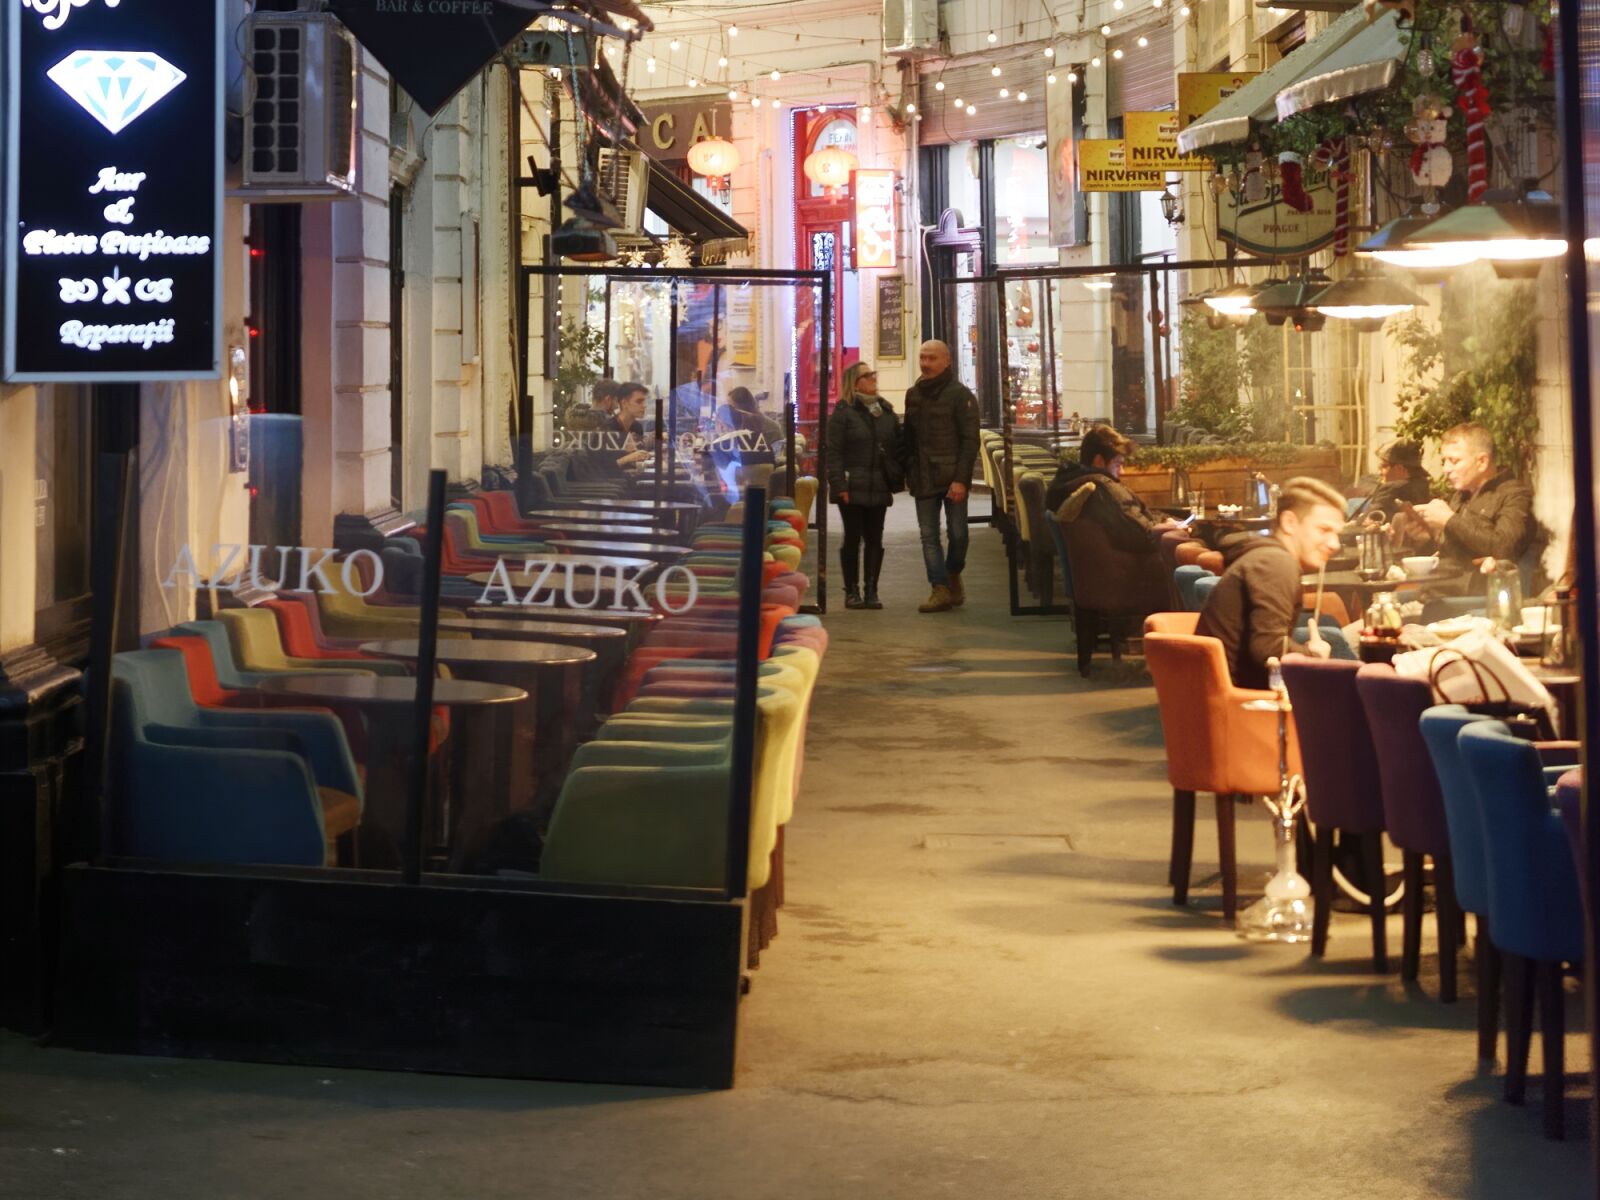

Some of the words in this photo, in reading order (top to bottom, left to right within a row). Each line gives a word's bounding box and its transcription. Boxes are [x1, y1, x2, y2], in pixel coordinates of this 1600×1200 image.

[376, 0, 408, 13] BAR
[412, 1, 424, 14] &
[428, 0, 494, 15] COFFEE
[1086, 169, 1161, 182] NIRVANA
[161, 543, 384, 597] AZUKO
[475, 557, 698, 614] AZUKO
